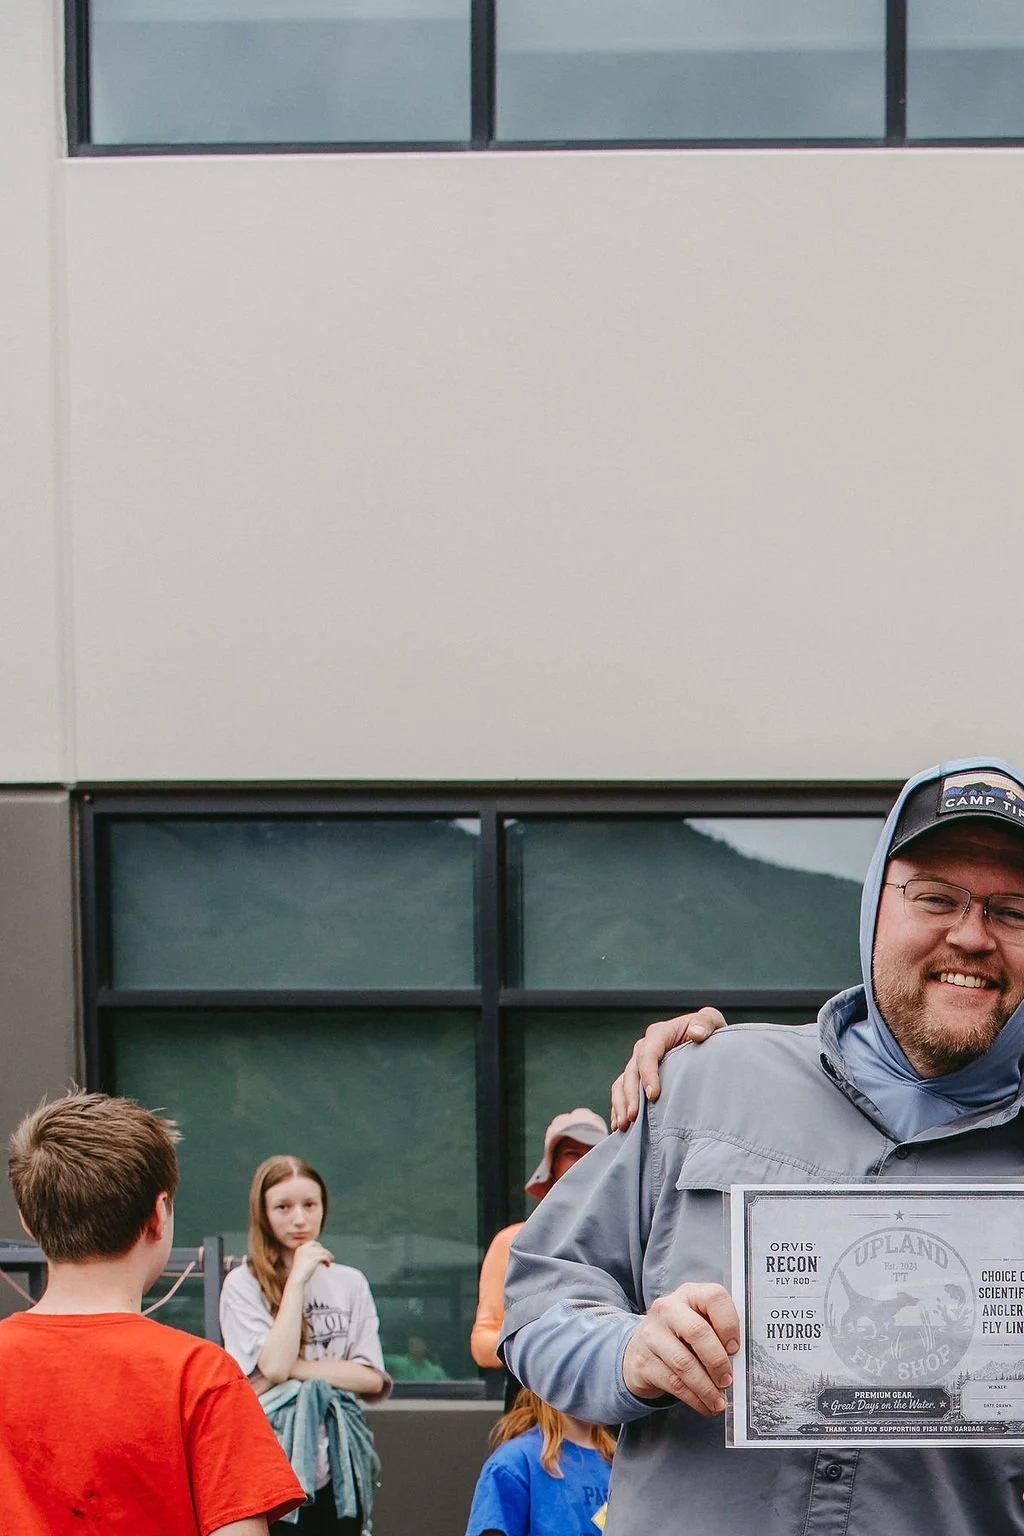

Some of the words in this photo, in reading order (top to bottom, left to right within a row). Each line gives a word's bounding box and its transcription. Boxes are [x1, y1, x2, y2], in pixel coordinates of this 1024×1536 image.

[945, 796, 995, 808] CAMP
[854, 1233, 949, 1269] UPLAND
[775, 1277, 790, 1285] FLY
[793, 1277, 810, 1285] ROD
[981, 1270, 1017, 1282] CHOICE
[982, 1321, 1002, 1334] FLY
[776, 1343, 790, 1351] FLY
[793, 1343, 812, 1351] REEL
[850, 1345, 888, 1377] FLY
[898, 1344, 951, 1381] SHOP
[854, 1391, 891, 1399] PREMIUM
[892, 1391, 915, 1399] GEAR.
[831, 1399, 856, 1413] Great
[857, 1399, 879, 1414] Days
[881, 1402, 892, 1410] on
[893, 1399, 907, 1410] the
[908, 1398, 936, 1410] Water.
